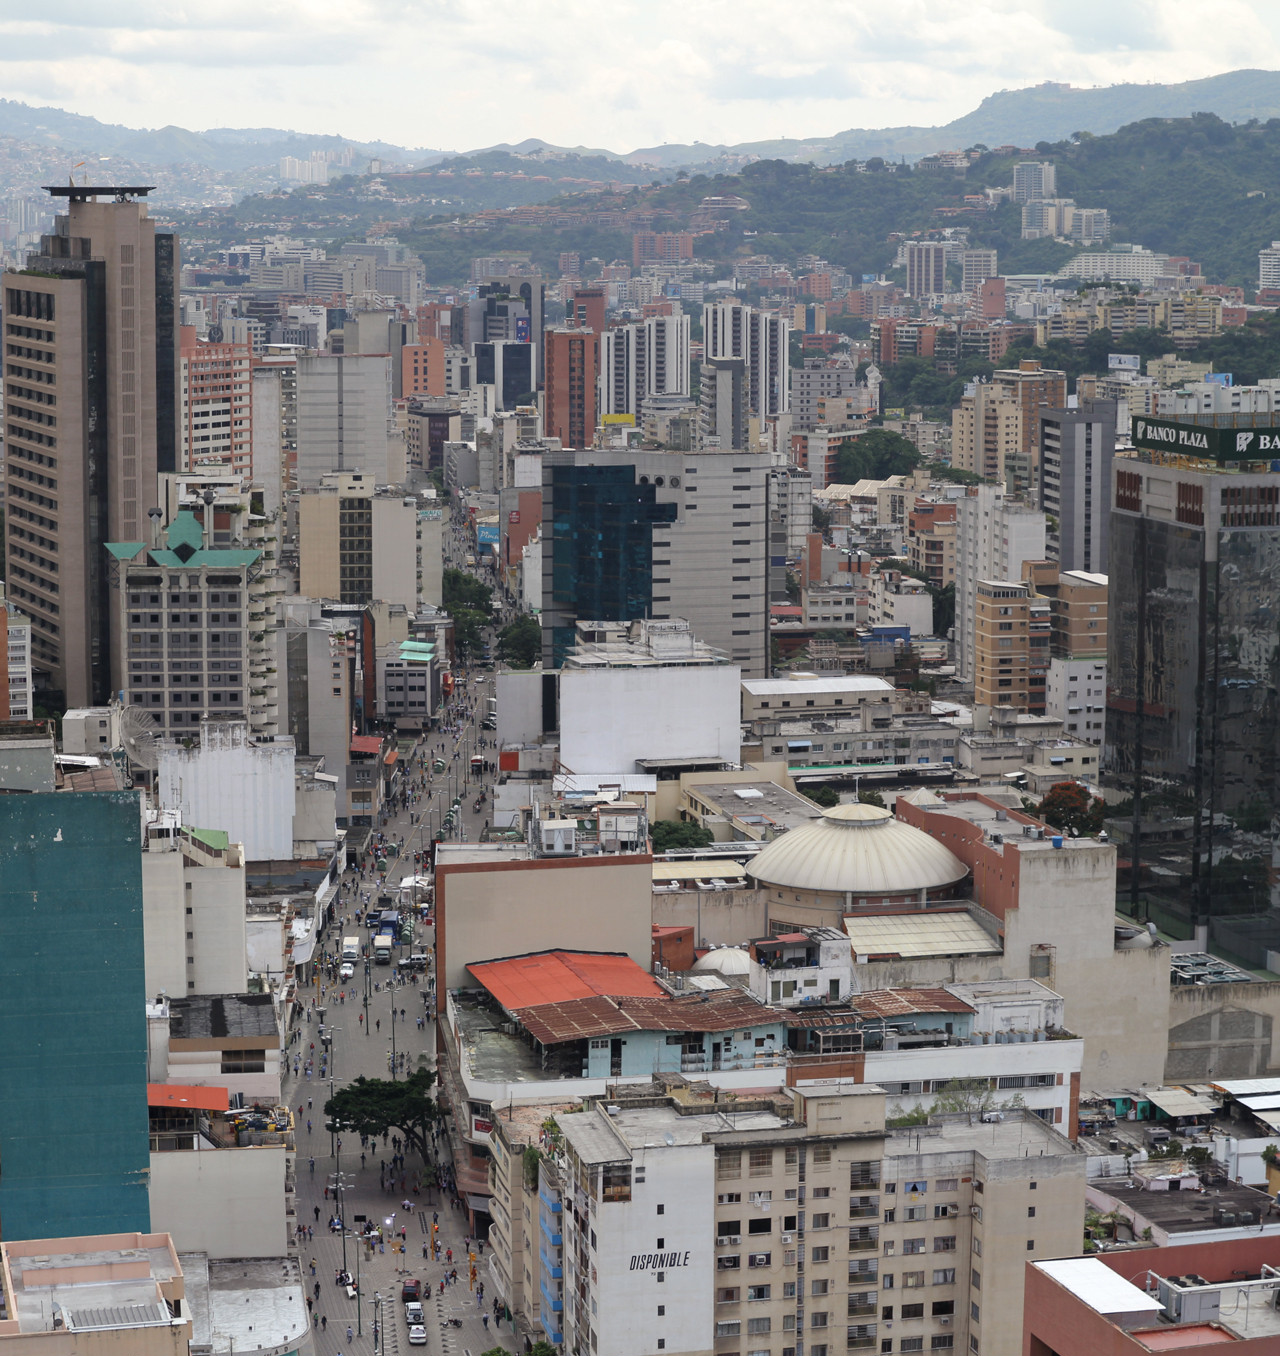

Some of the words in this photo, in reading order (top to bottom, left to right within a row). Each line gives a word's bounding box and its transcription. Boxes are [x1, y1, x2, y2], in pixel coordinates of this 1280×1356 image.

[1146, 425, 1176, 443] BANCO
[1179, 430, 1209, 449] PLAZA
[629, 1250, 691, 1271] DISPONIBLE
